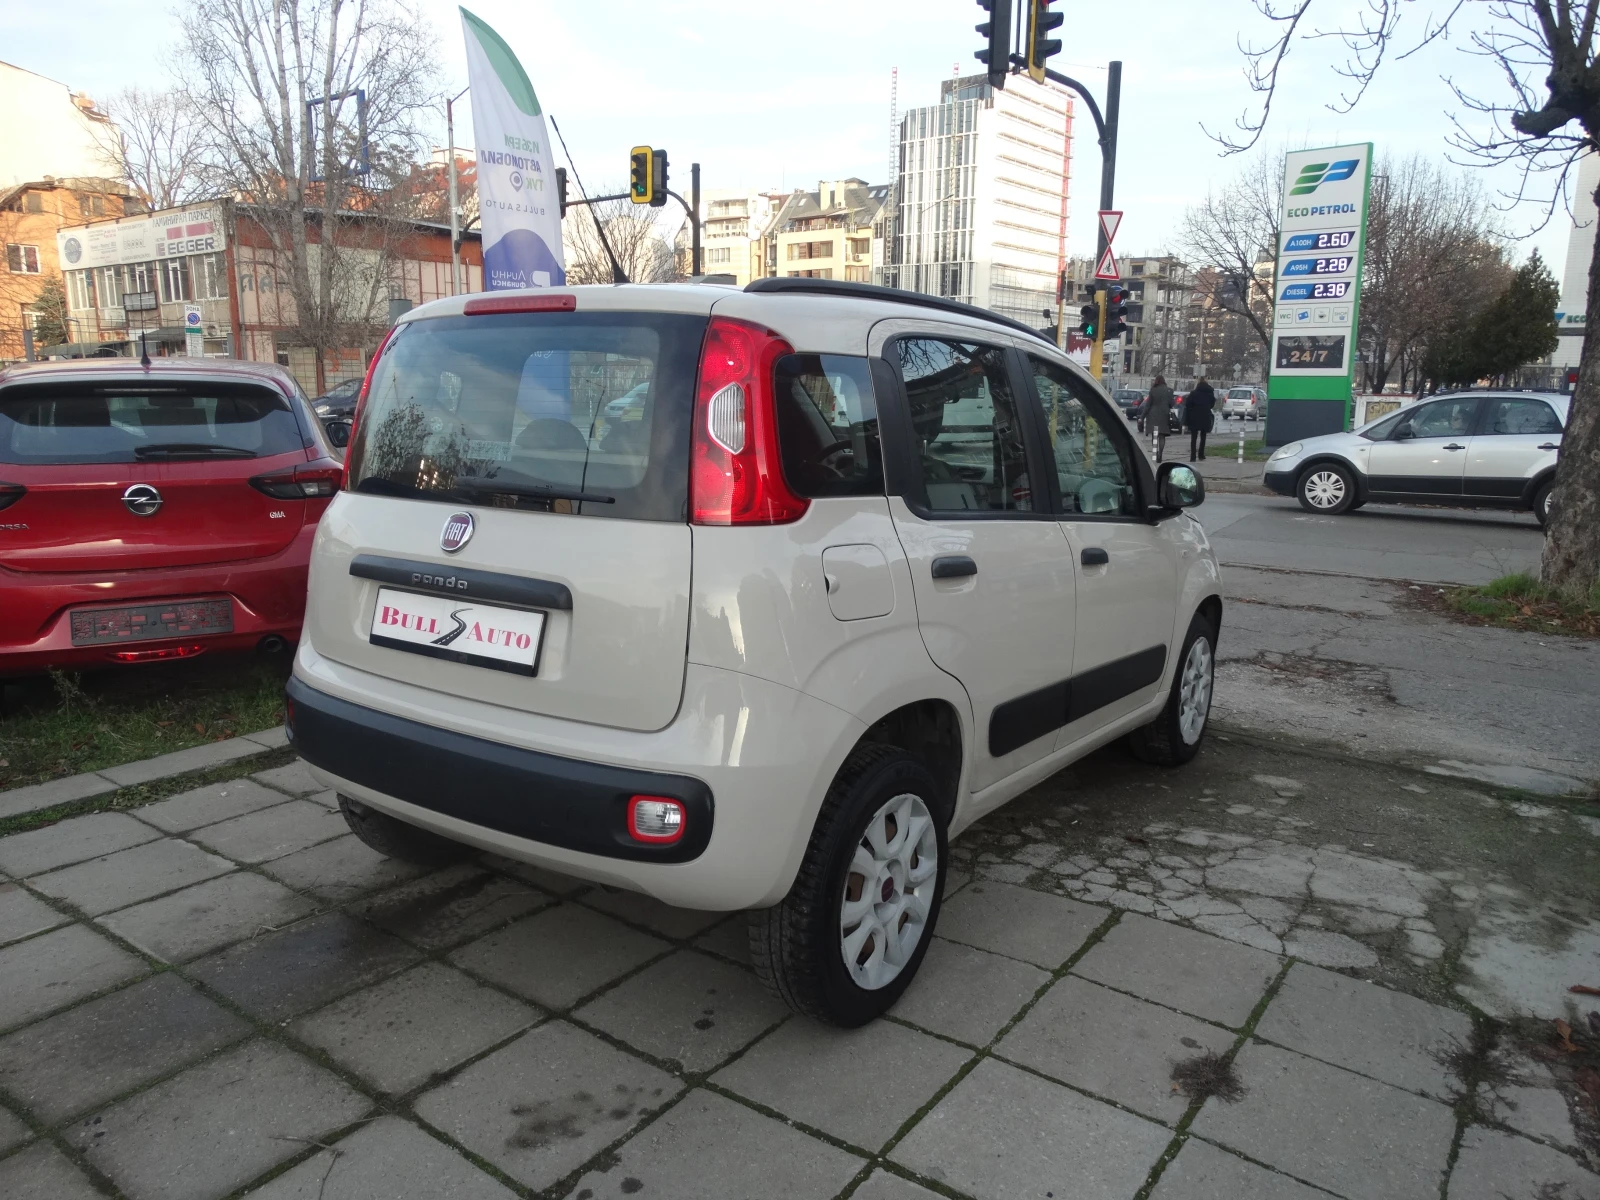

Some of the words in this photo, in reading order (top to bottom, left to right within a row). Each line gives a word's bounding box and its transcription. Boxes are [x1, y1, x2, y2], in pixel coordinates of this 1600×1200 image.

[1311, 203, 1356, 216] PETROL
[167, 237, 215, 256] EGGER
[1318, 232, 1349, 248] 2.60
[1316, 258, 1348, 272] 2.28
[1286, 288, 1307, 296] DIESEL
[1314, 283, 1346, 297] 2.38
[1290, 350, 1329, 363] 24/7
[445, 521, 468, 542] FIAT
